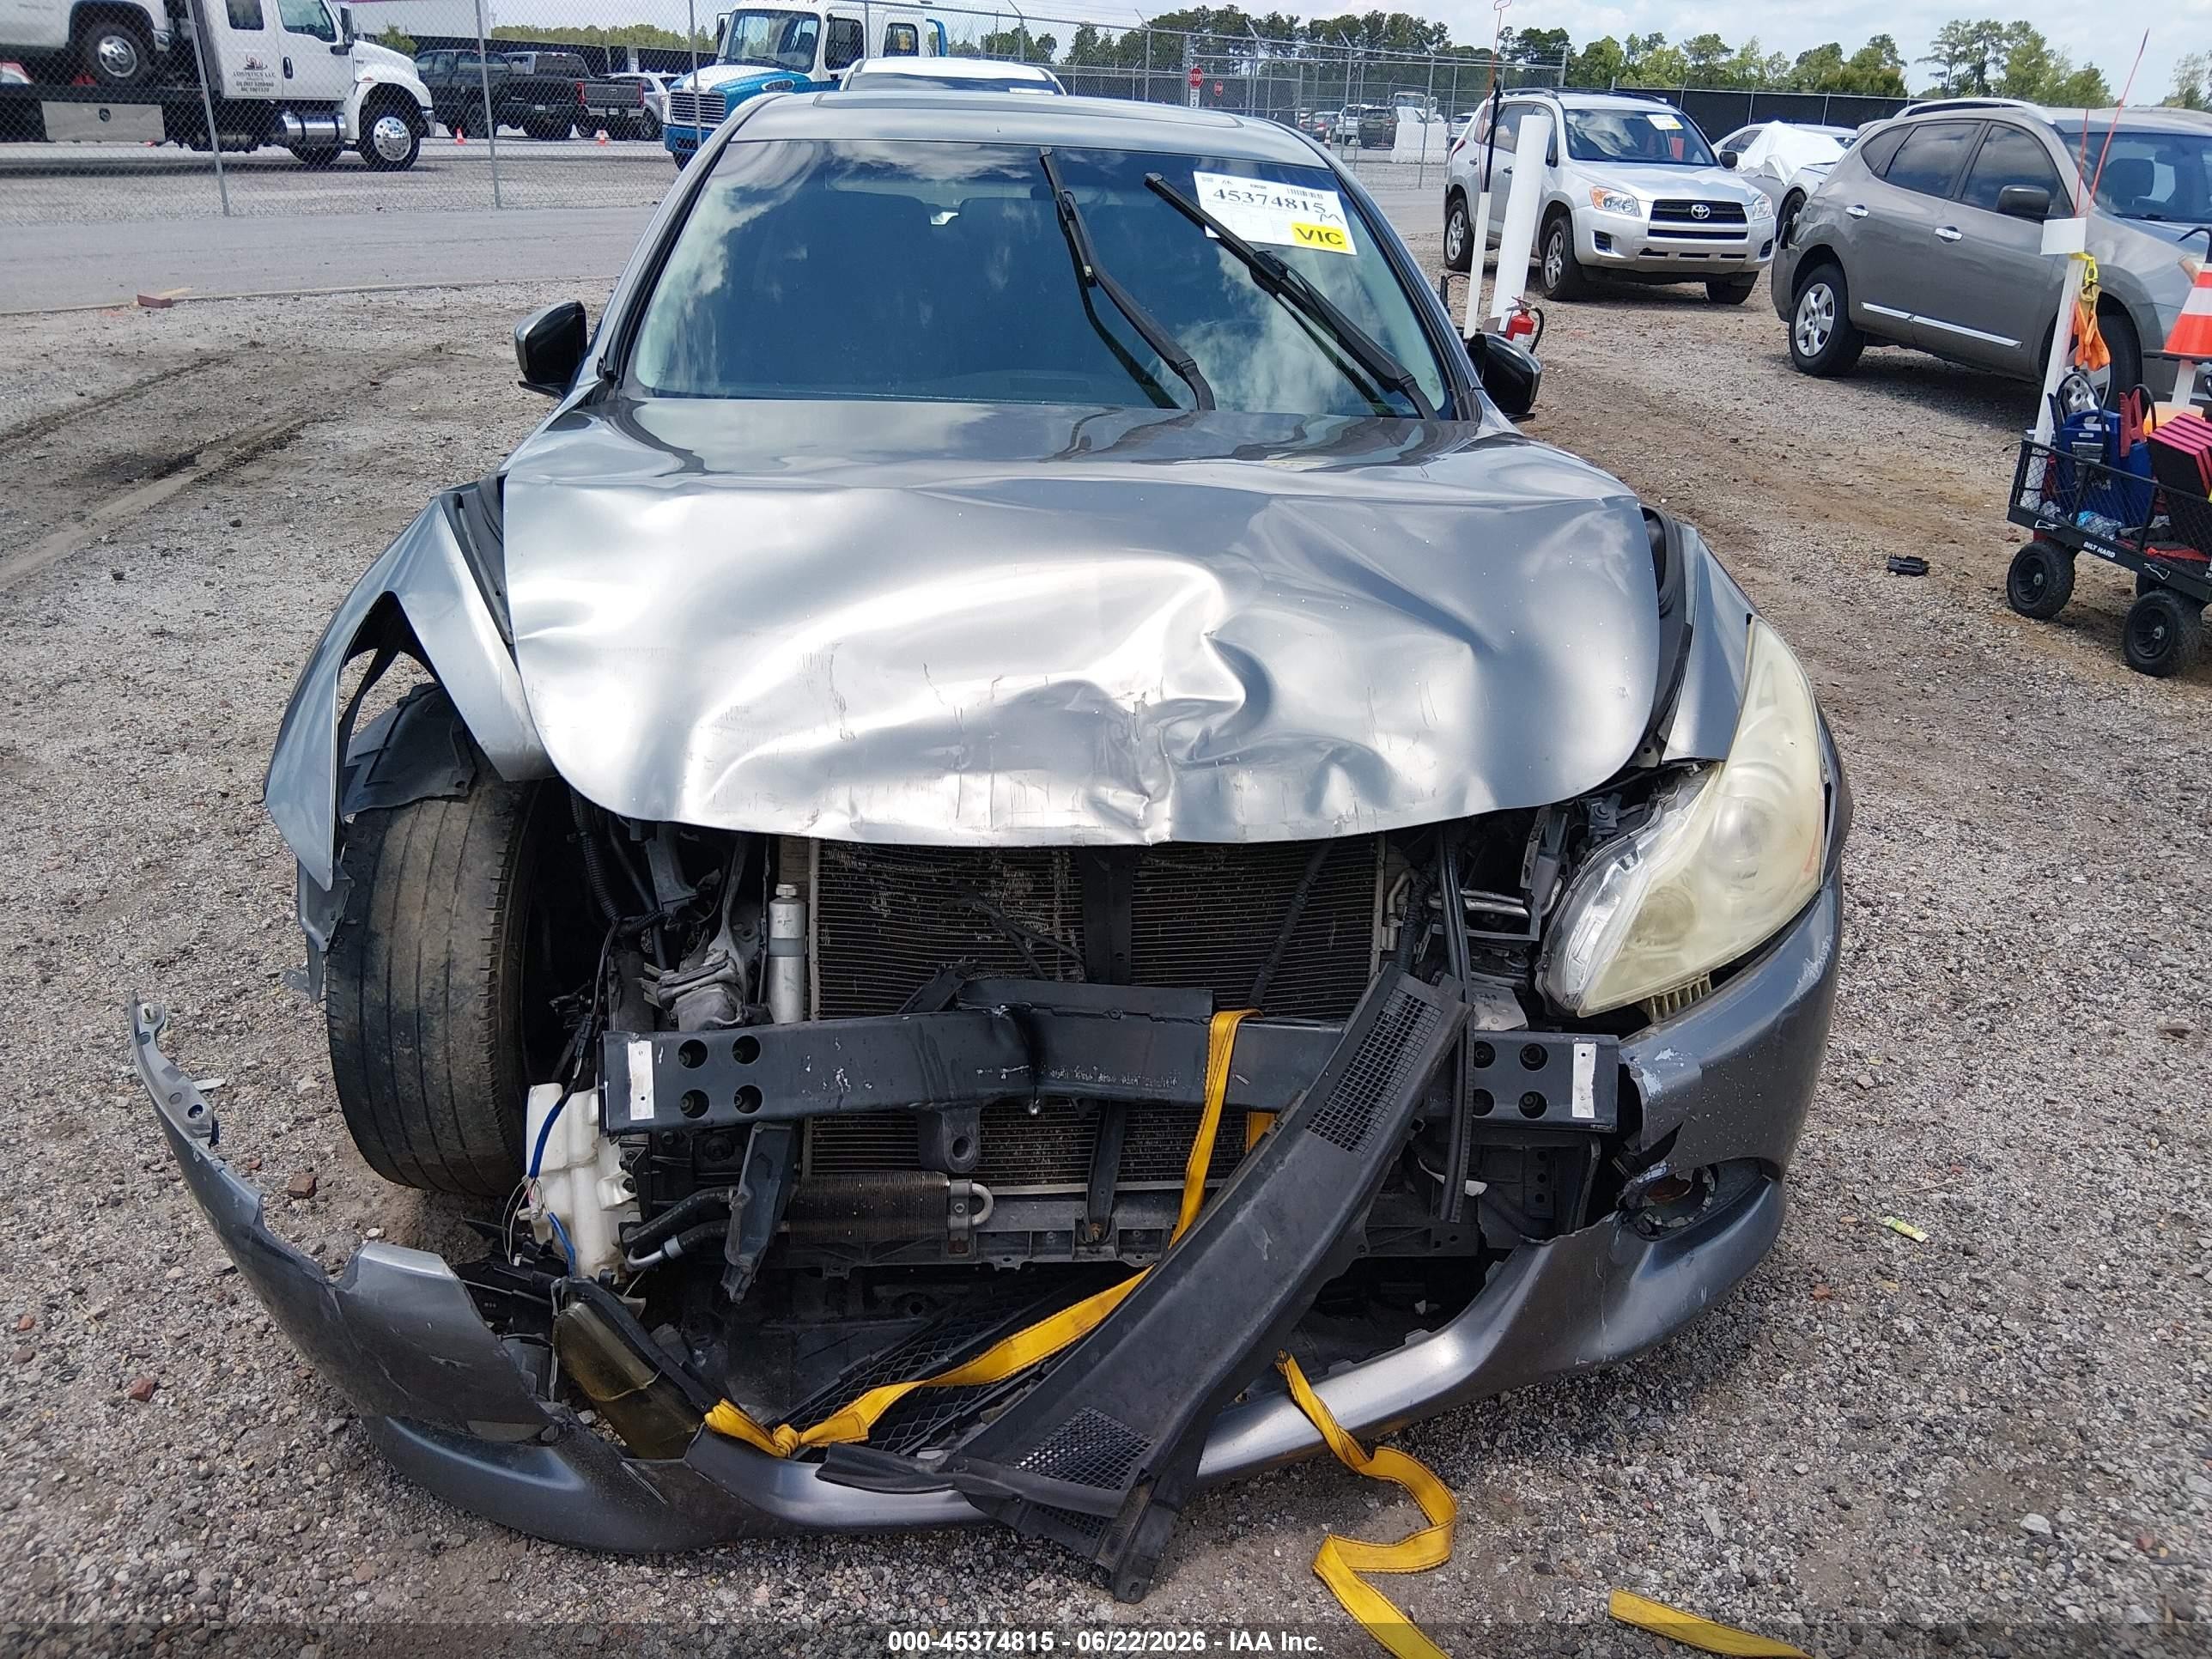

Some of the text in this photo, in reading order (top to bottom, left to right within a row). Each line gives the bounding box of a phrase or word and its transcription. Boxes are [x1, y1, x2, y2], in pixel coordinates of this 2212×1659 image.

[1189, 73, 1202, 82] STOP
[1212, 188, 1326, 214] 45374815
[1295, 227, 1343, 245] VIC
[2083, 541, 2116, 558] BILT HARD
